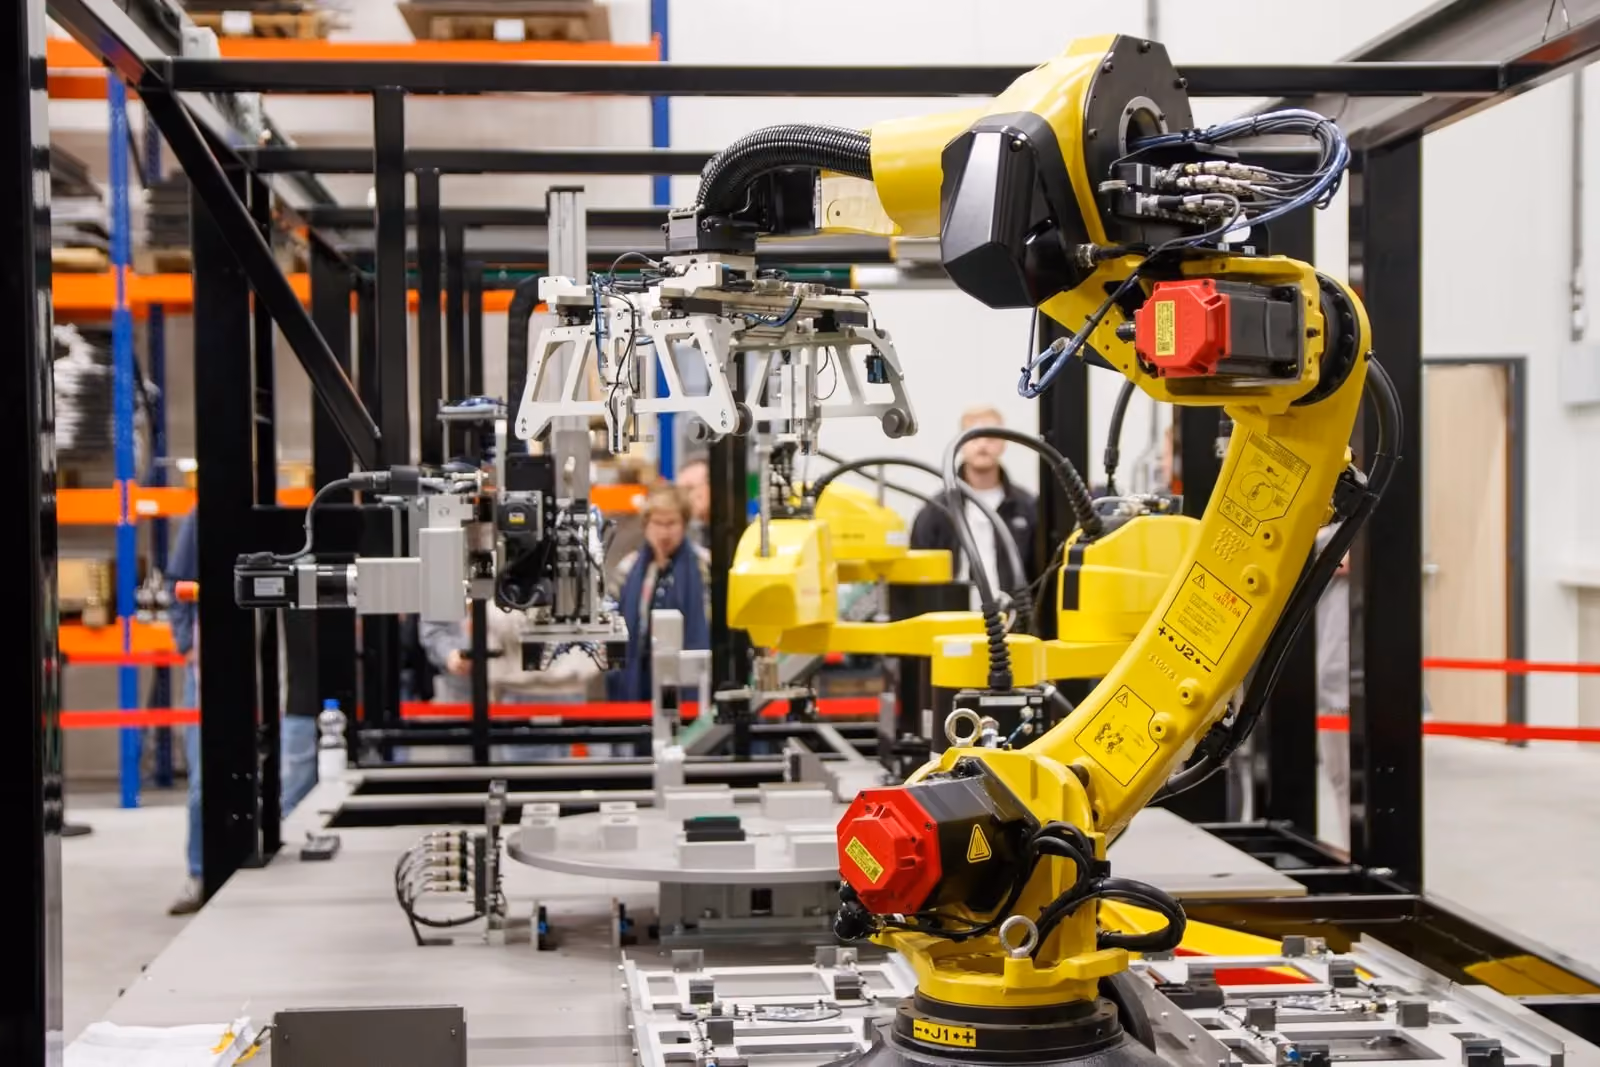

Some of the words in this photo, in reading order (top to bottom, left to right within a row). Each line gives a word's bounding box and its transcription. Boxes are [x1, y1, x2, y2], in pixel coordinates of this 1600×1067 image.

[1212, 592, 1241, 618] CAUTION
[1174, 643, 1195, 661] J2
[930, 1027, 949, 1041] J1
